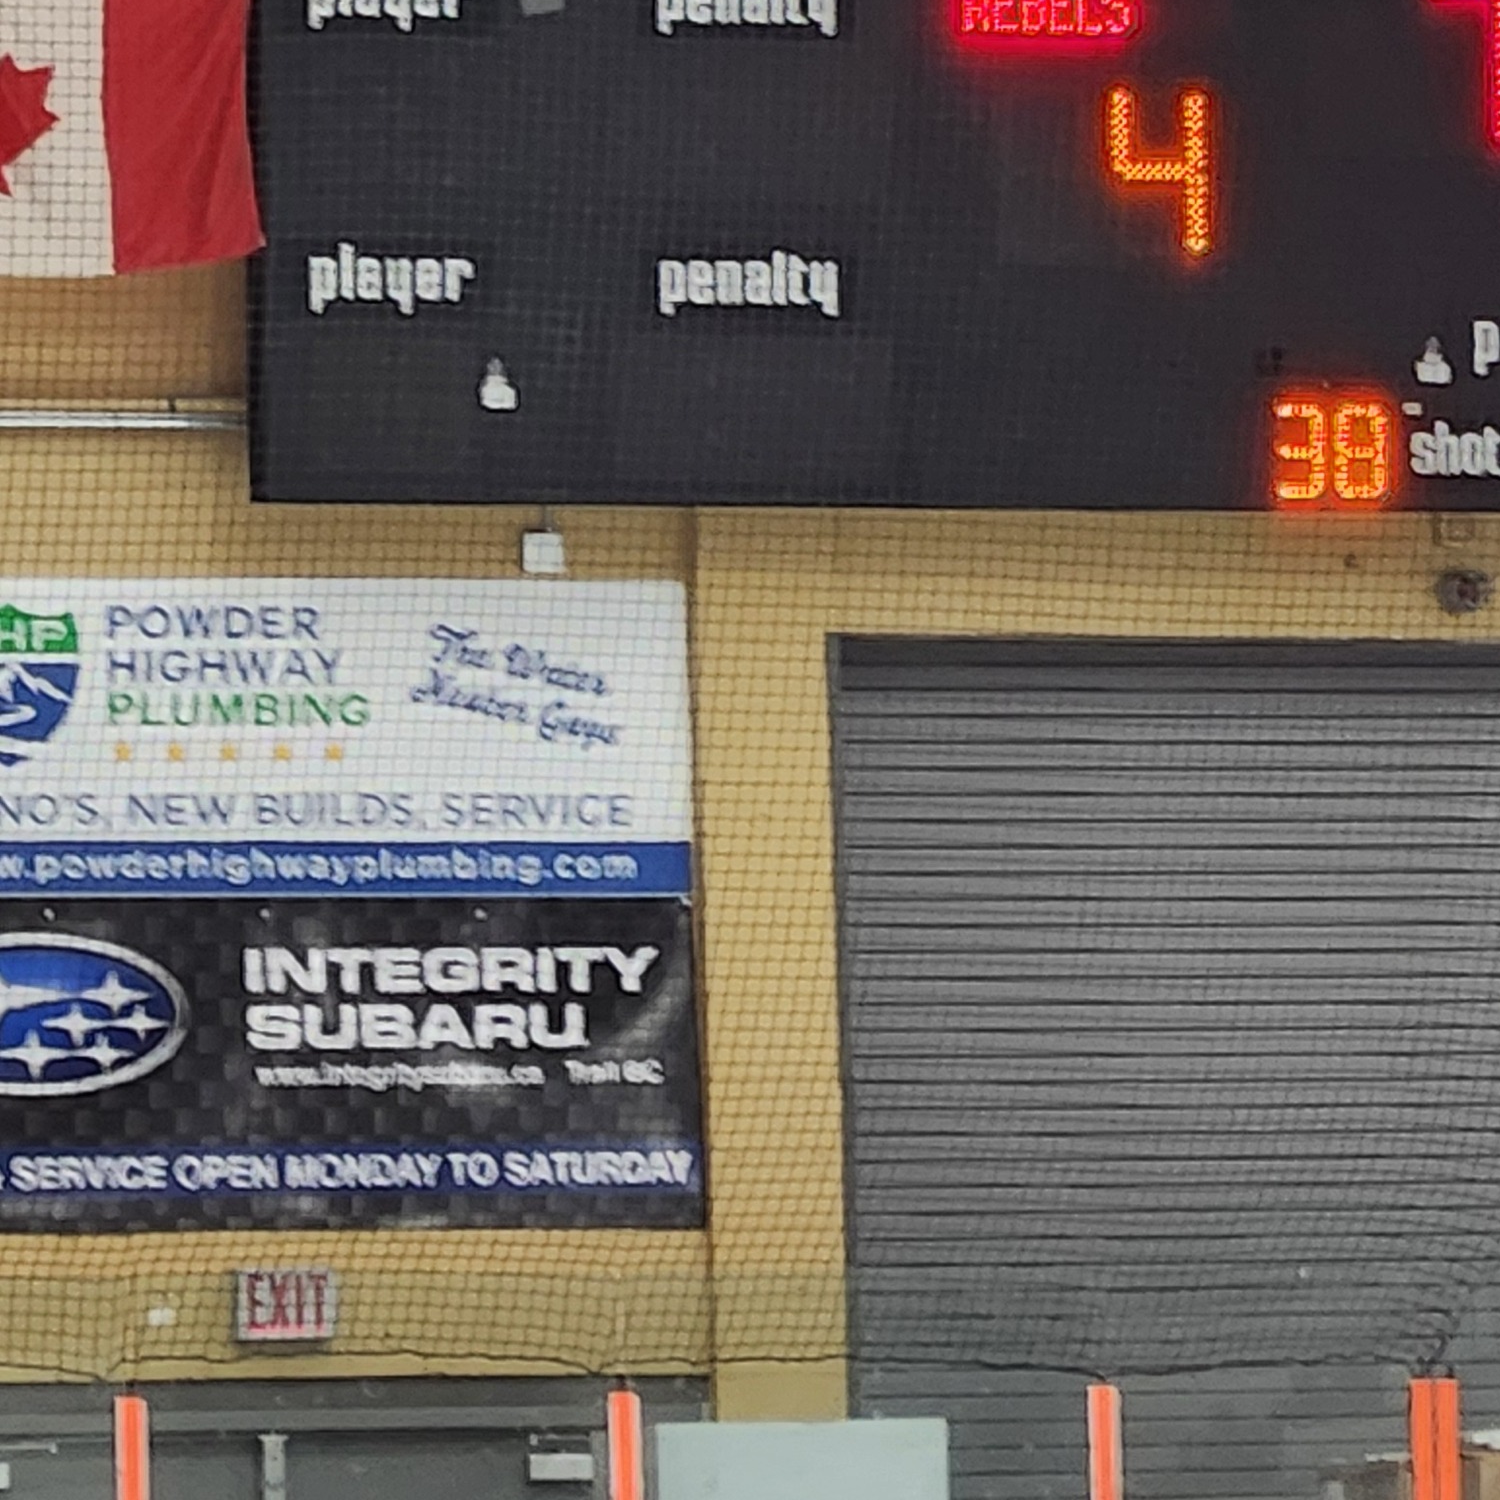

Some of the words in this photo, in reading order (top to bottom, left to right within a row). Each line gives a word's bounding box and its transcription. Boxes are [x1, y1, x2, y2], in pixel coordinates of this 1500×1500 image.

[1106, 88, 1212, 255] 4
[307, 241, 476, 315] player
[657, 249, 840, 316] penalty
[1275, 402, 1391, 500] 38
[106, 604, 320, 640] POWDER
[107, 648, 341, 685] HIGHWAY
[107, 692, 371, 726] PLUMBING
[127, 794, 230, 826] NEW
[443, 793, 633, 827] SERVICE
[242, 946, 660, 994] INTEGRITY
[245, 1002, 591, 1050] SUBARU
[9, 1155, 168, 1191] SERVICE
[171, 1154, 279, 1191] OPEN
[284, 1153, 442, 1189] MONDAY
[446, 1152, 499, 1187] TO
[503, 1151, 692, 1186] SATURDAY
[247, 1272, 327, 1331] EXIT
